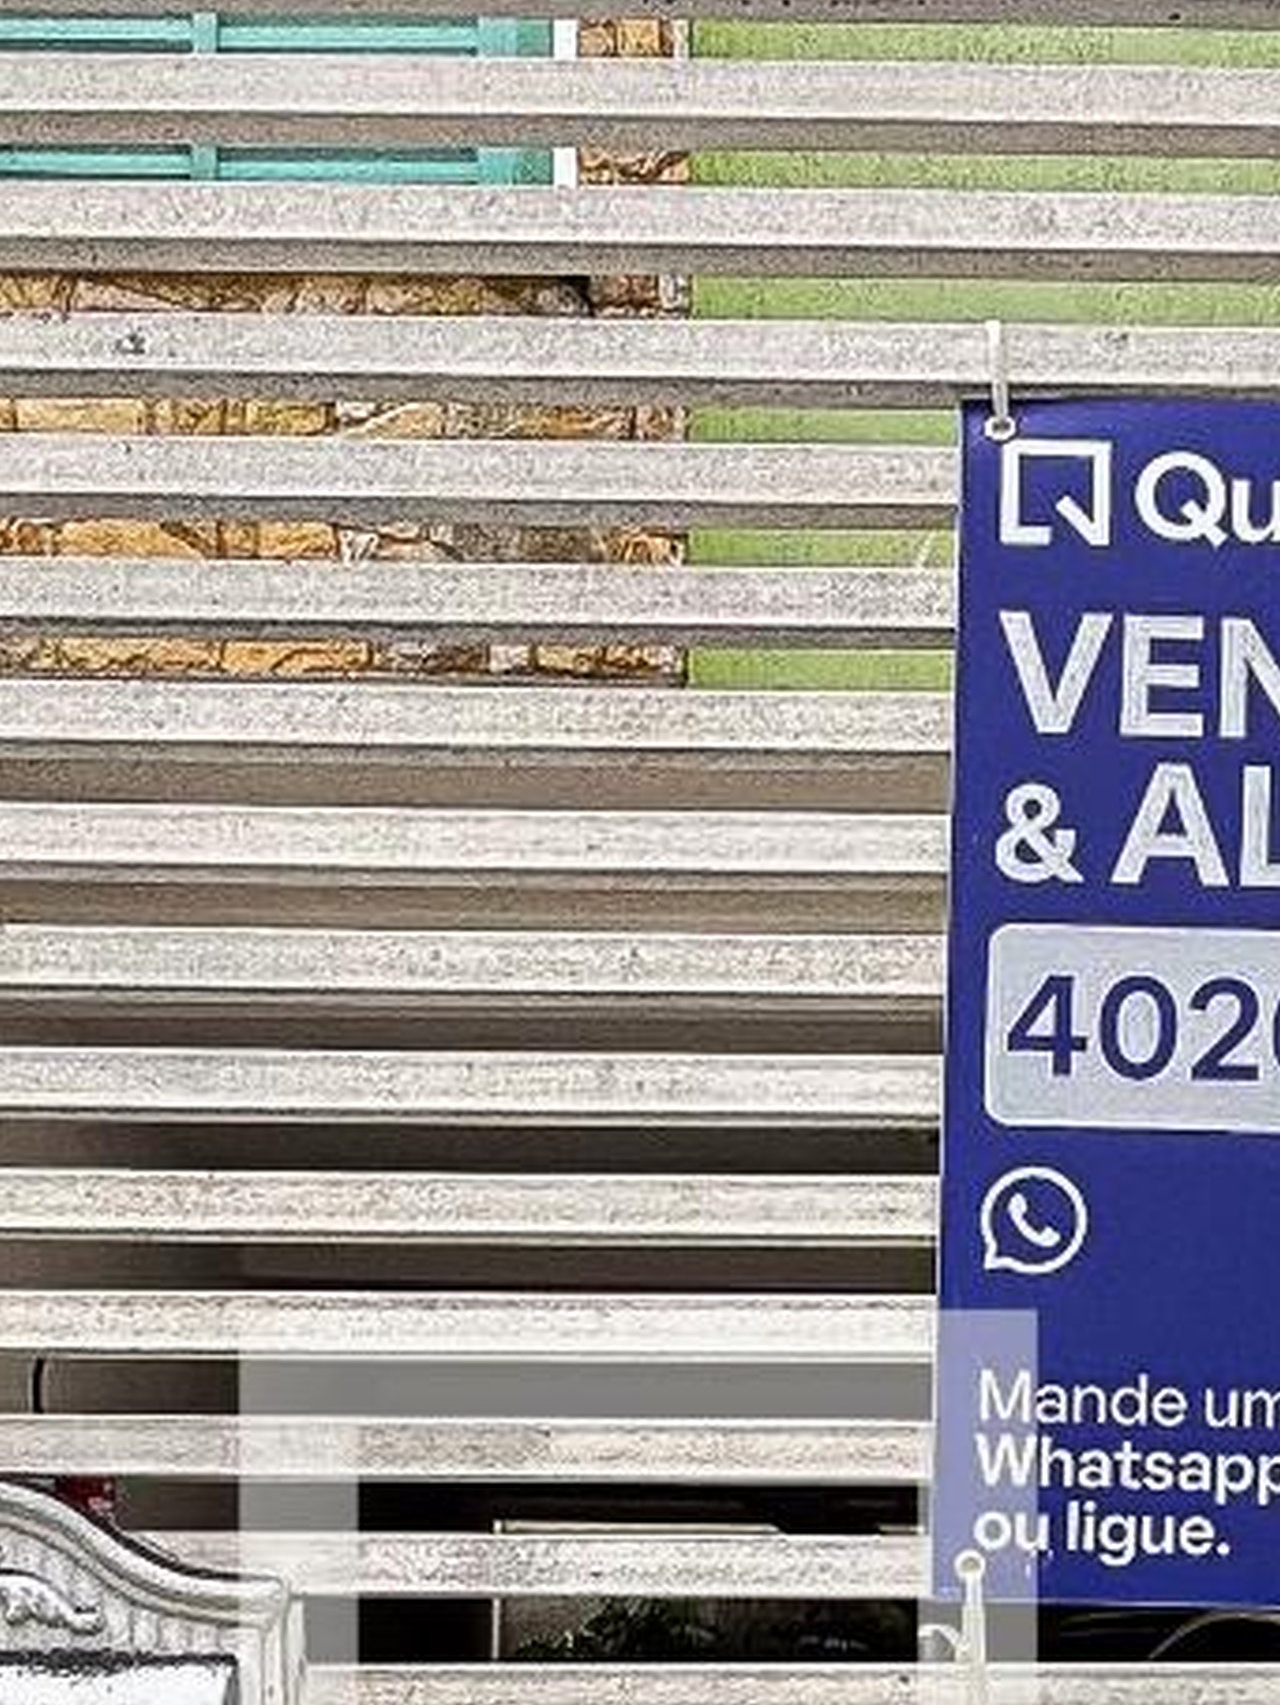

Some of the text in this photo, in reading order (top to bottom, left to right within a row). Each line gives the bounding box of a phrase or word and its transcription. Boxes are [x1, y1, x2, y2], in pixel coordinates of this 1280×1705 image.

[993, 782, 1084, 884] &
[978, 1368, 1188, 1427] Mande
[972, 1499, 1231, 1566] ou ligue.
